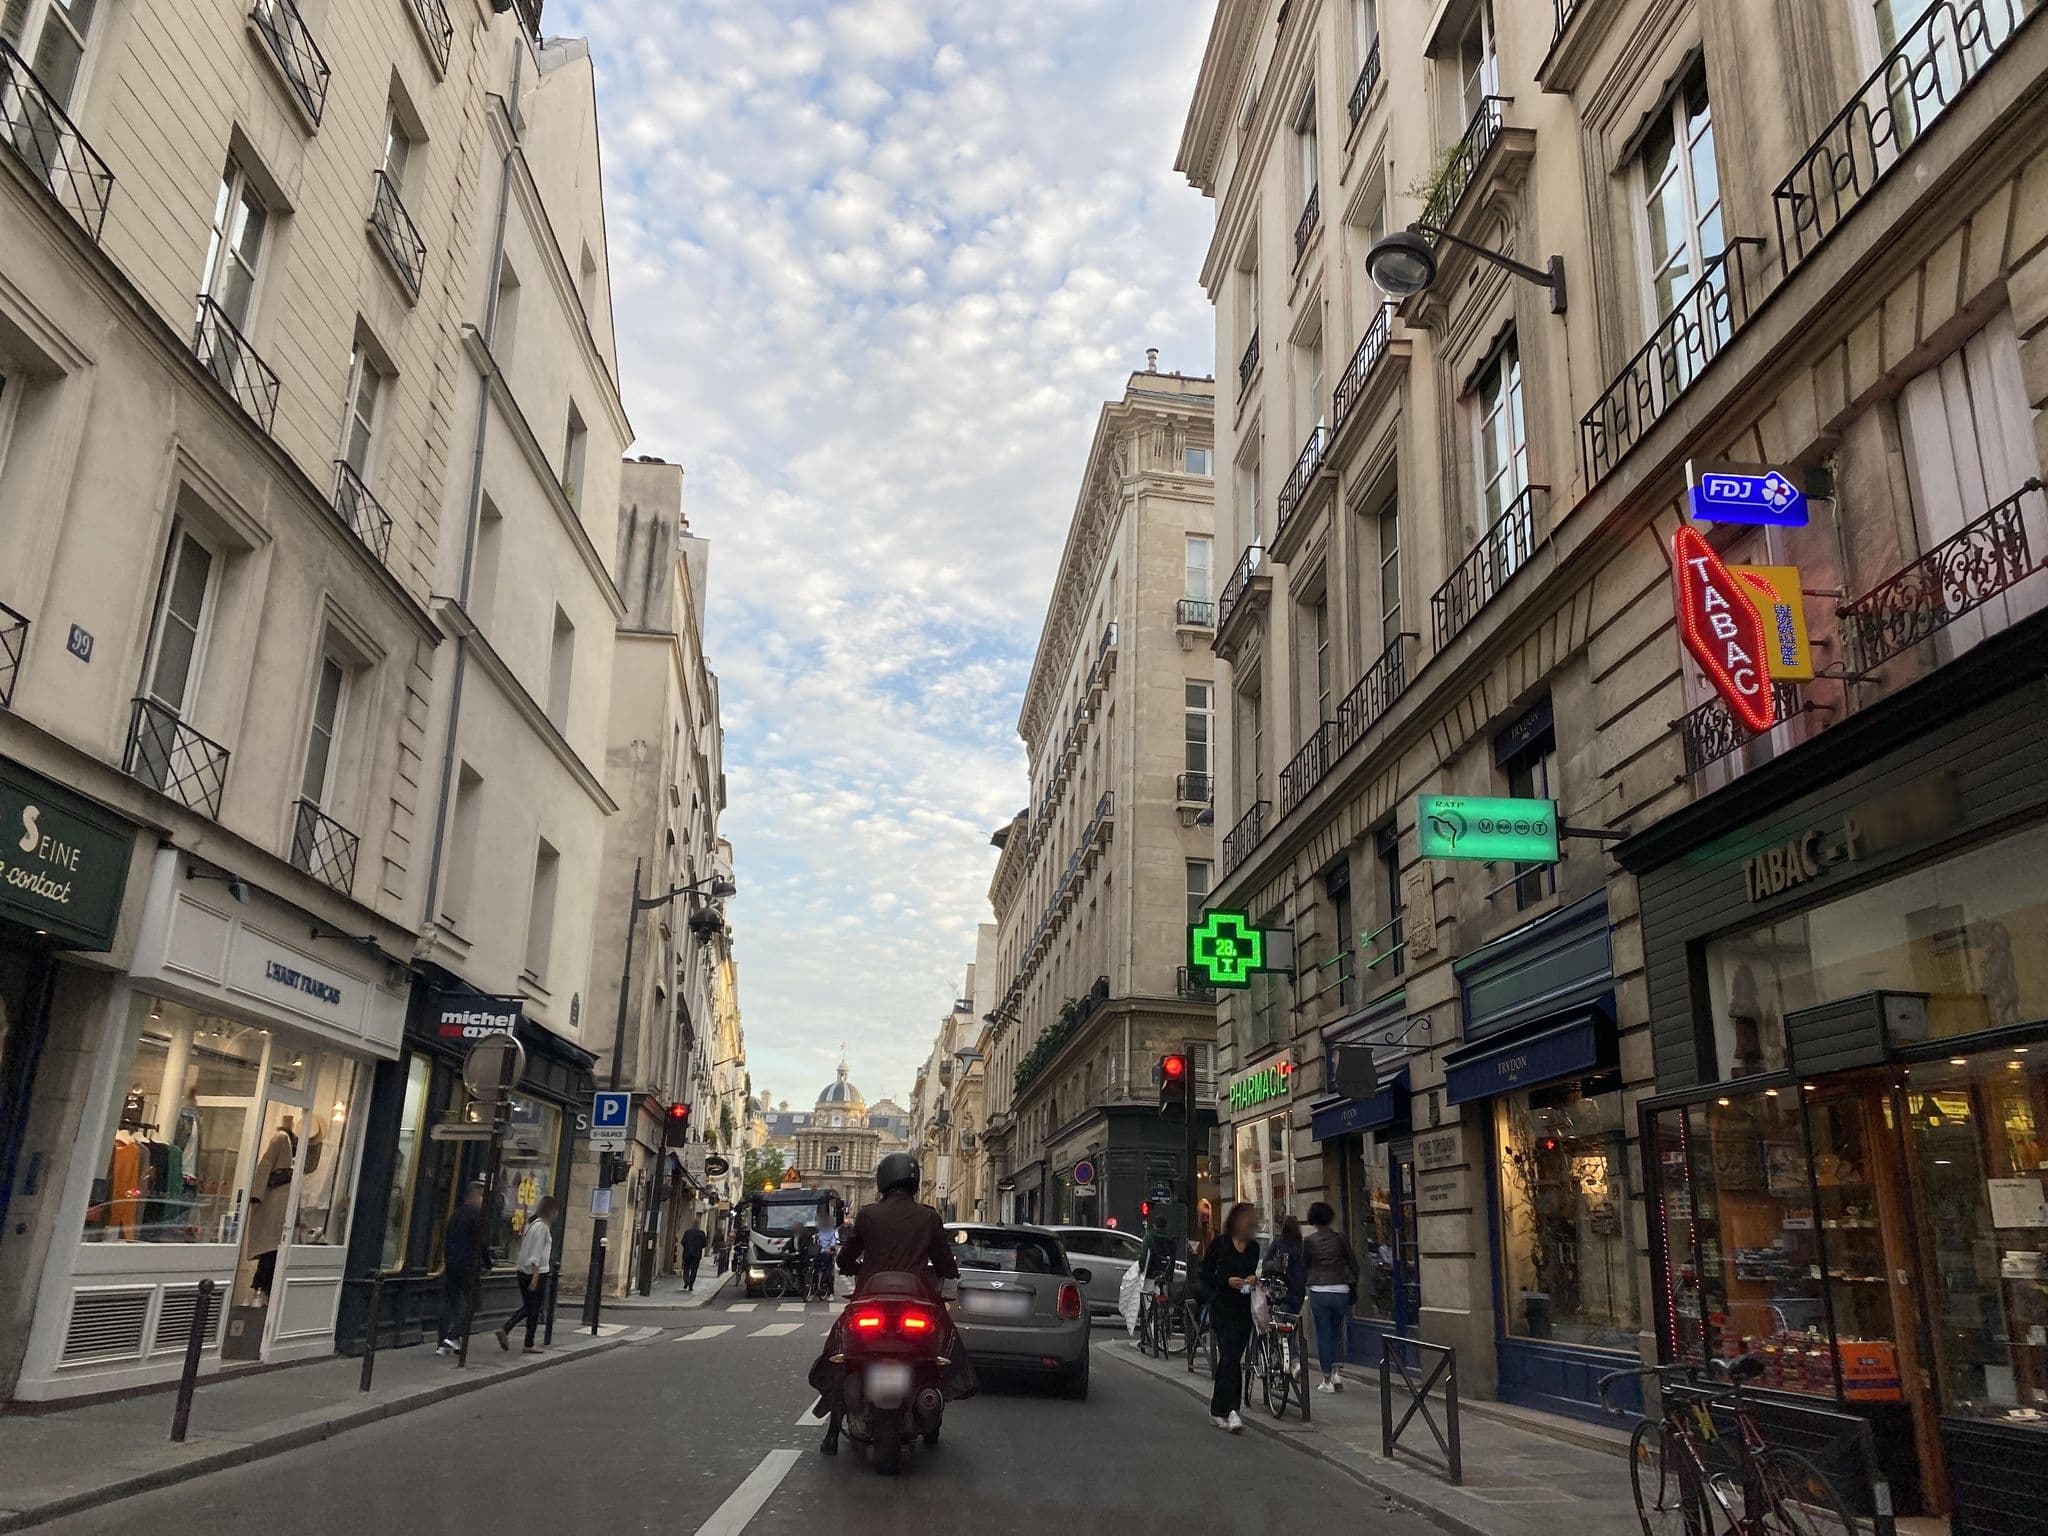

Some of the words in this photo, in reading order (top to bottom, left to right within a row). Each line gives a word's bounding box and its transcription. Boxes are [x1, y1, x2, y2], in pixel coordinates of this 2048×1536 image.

[1709, 479, 1752, 499] FDJ
[72, 629, 90, 656] 99
[1688, 556, 1760, 695] TABAC
[1774, 603, 1800, 666] PRESSE
[18, 805, 81, 872] SEINE
[6, 867, 71, 904] contact
[1743, 829, 1818, 902] TABAC
[441, 1010, 516, 1027] michel
[1229, 1061, 1288, 1113] PHARMACIE
[602, 1100, 619, 1121] P
